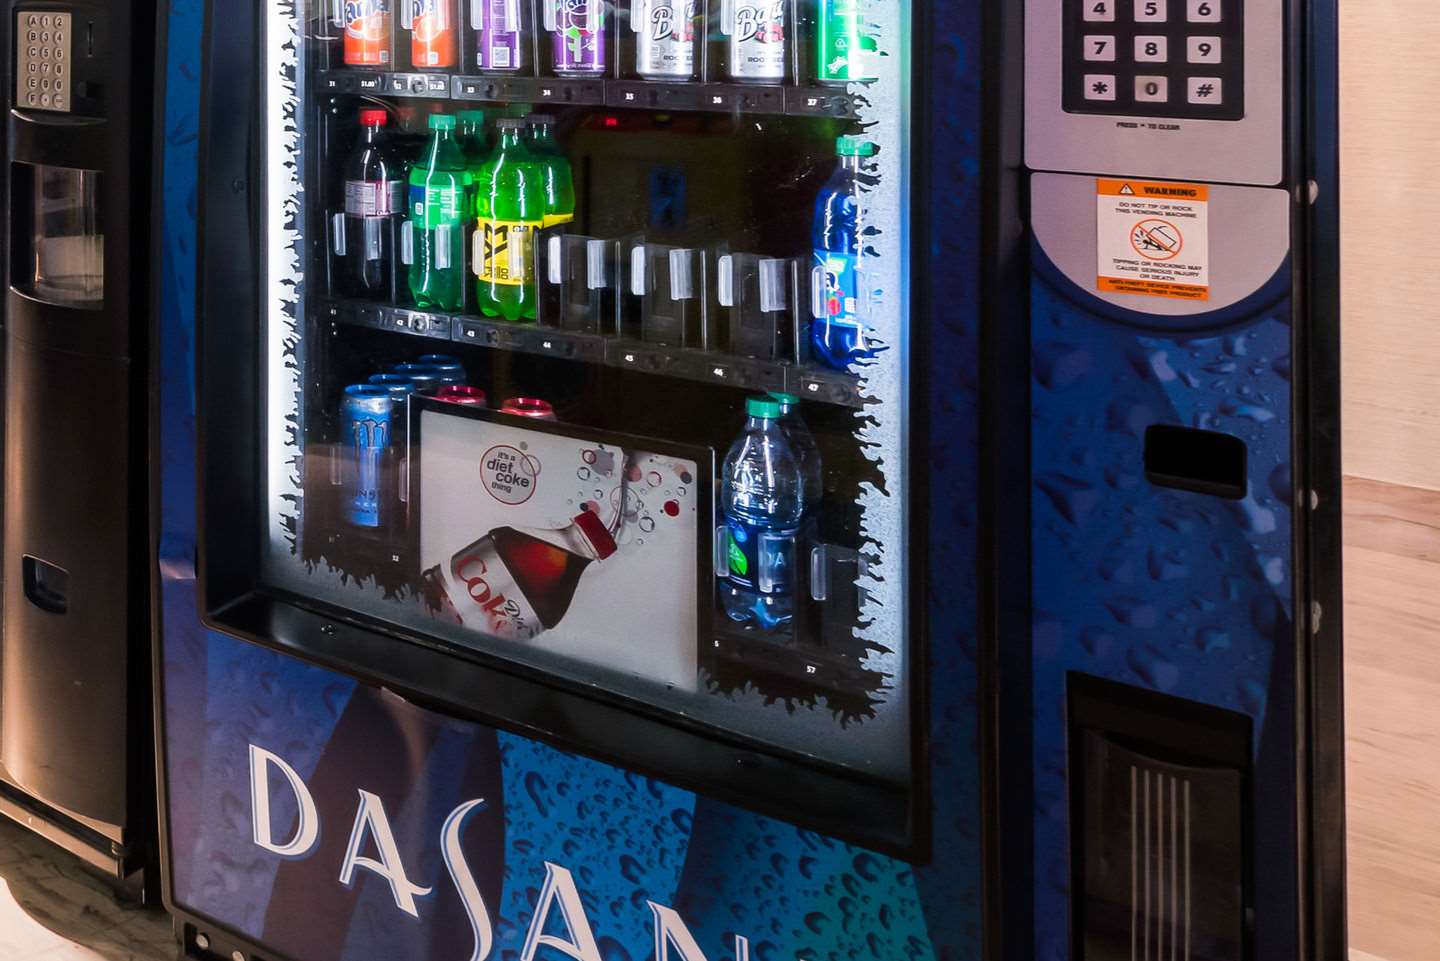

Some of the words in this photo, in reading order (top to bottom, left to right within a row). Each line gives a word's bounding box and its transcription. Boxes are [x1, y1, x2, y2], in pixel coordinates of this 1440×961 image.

[1092, 2, 1107, 16] 4
[1144, 2, 1158, 16] 5
[1197, 2, 1212, 16] 6
[1093, 41, 1107, 55] 7
[1144, 42, 1158, 56] 8
[1197, 42, 1212, 57] 9
[1145, 81, 1158, 96] 0
[1196, 83, 1214, 98] #
[1143, 186, 1198, 198] WARNING
[1132, 208, 1164, 216] VENDING
[1113, 258, 1140, 266] TIPPING
[1153, 262, 1186, 270] ROCKING
[1141, 267, 1172, 275] SERIOUS
[1173, 269, 1200, 277] INJURY
[497, 451, 510, 460] it's
[486, 458, 514, 474] diet
[495, 471, 530, 488] coke
[491, 481, 513, 493] thing
